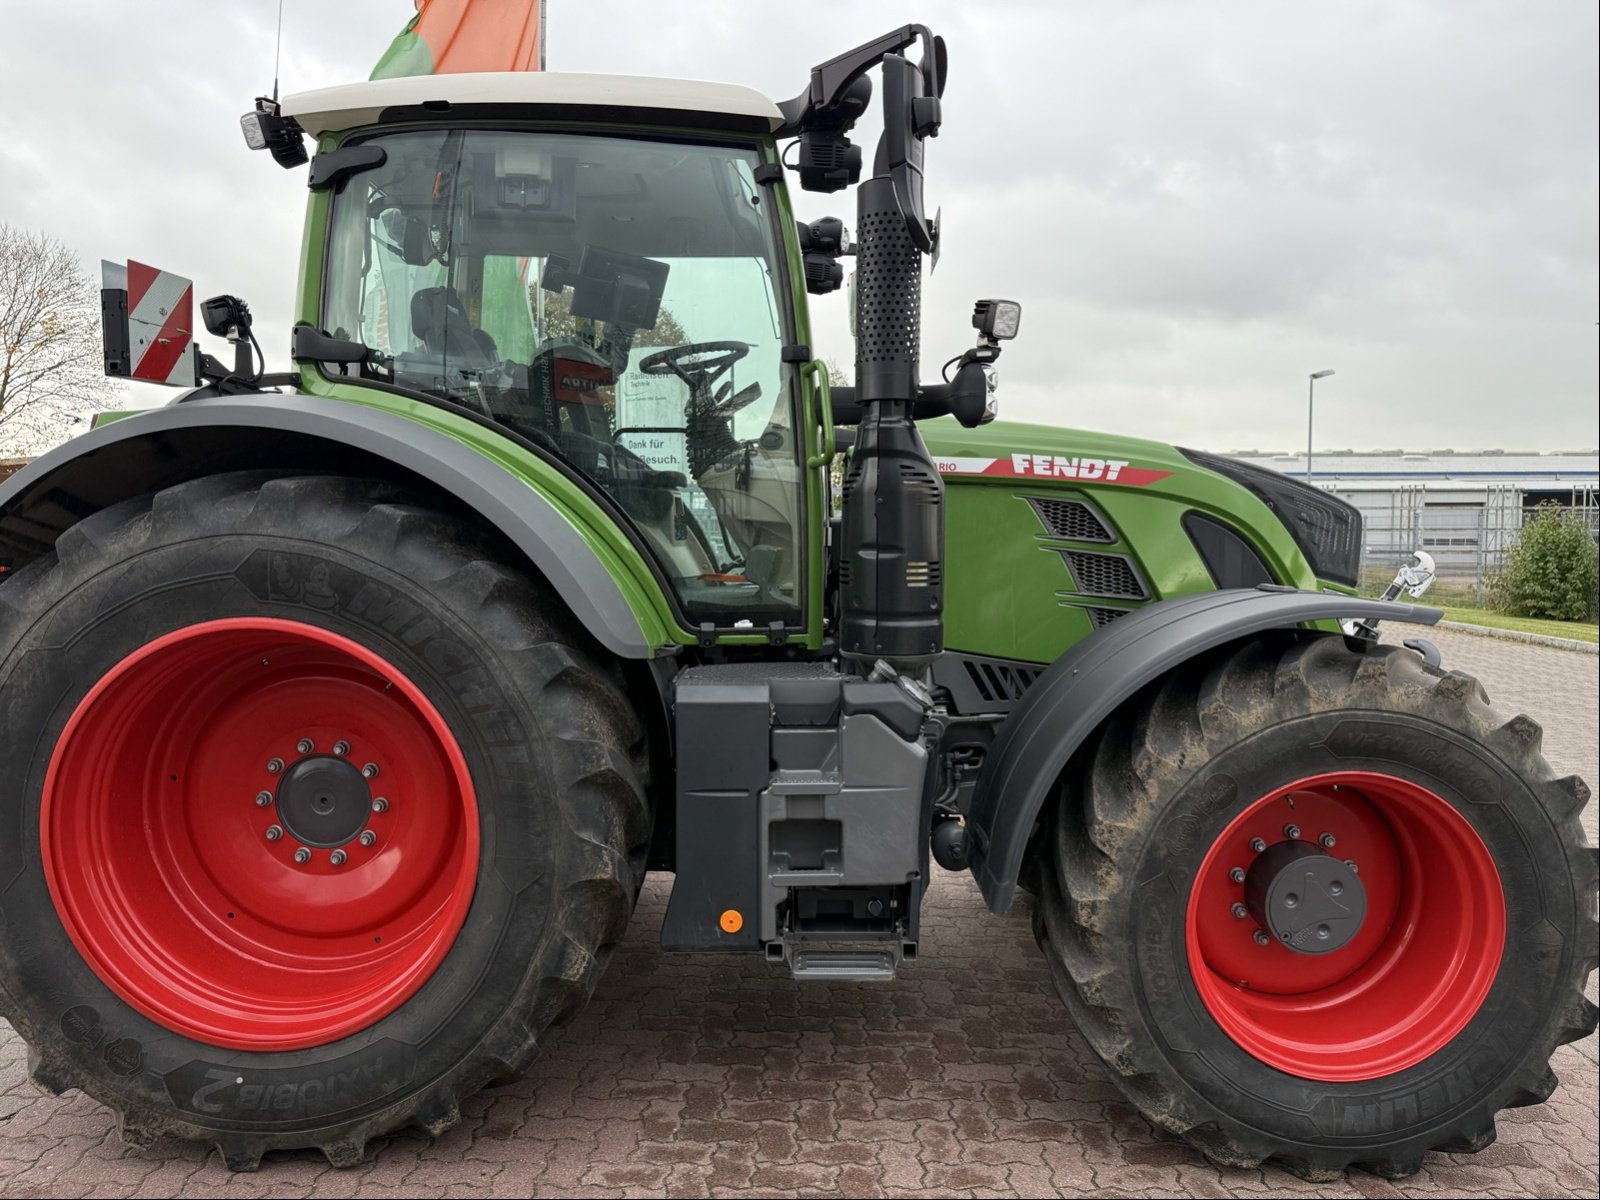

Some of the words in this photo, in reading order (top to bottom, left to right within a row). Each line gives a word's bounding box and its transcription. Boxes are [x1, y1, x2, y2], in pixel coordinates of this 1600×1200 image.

[628, 439, 647, 450] Dank
[649, 438, 664, 449] für
[1011, 453, 1129, 481] FENDT
[191, 1067, 242, 1113] 2
